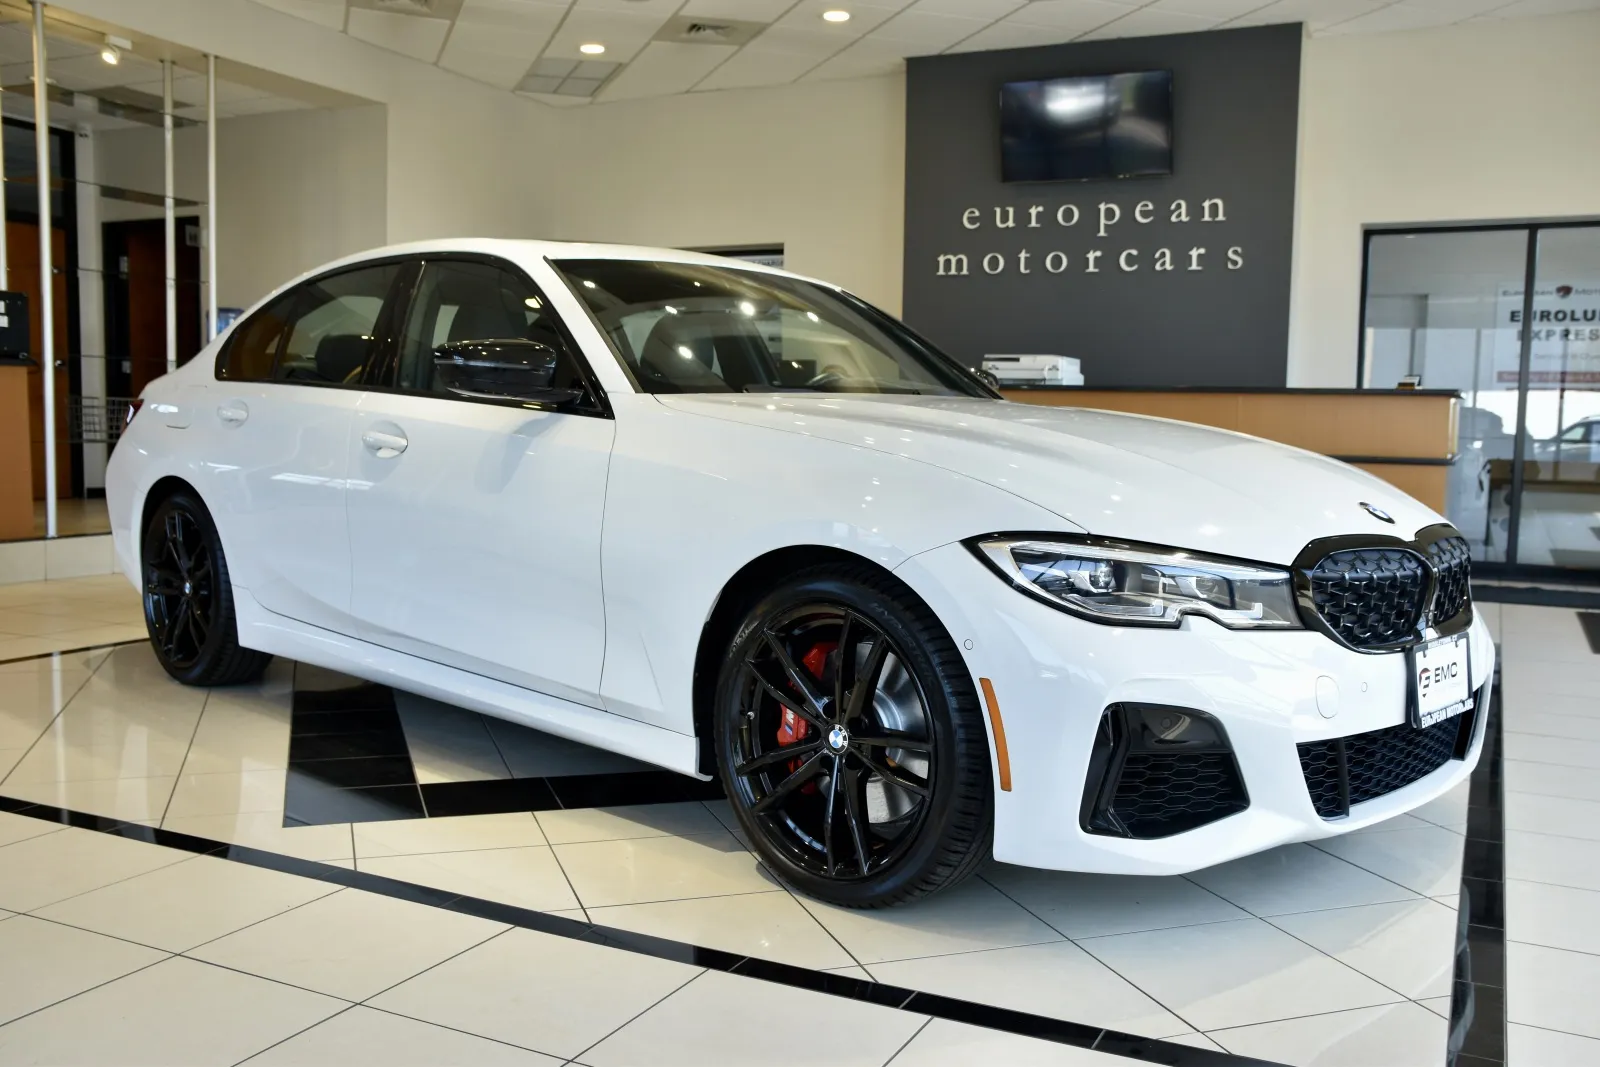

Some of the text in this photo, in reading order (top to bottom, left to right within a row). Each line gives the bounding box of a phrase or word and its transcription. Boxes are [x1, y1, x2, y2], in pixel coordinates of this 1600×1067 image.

[962, 196, 1226, 236] european
[936, 245, 1244, 275] motorcars
[1509, 309, 1600, 322] EROLU
[1434, 661, 1458, 683] EMC
